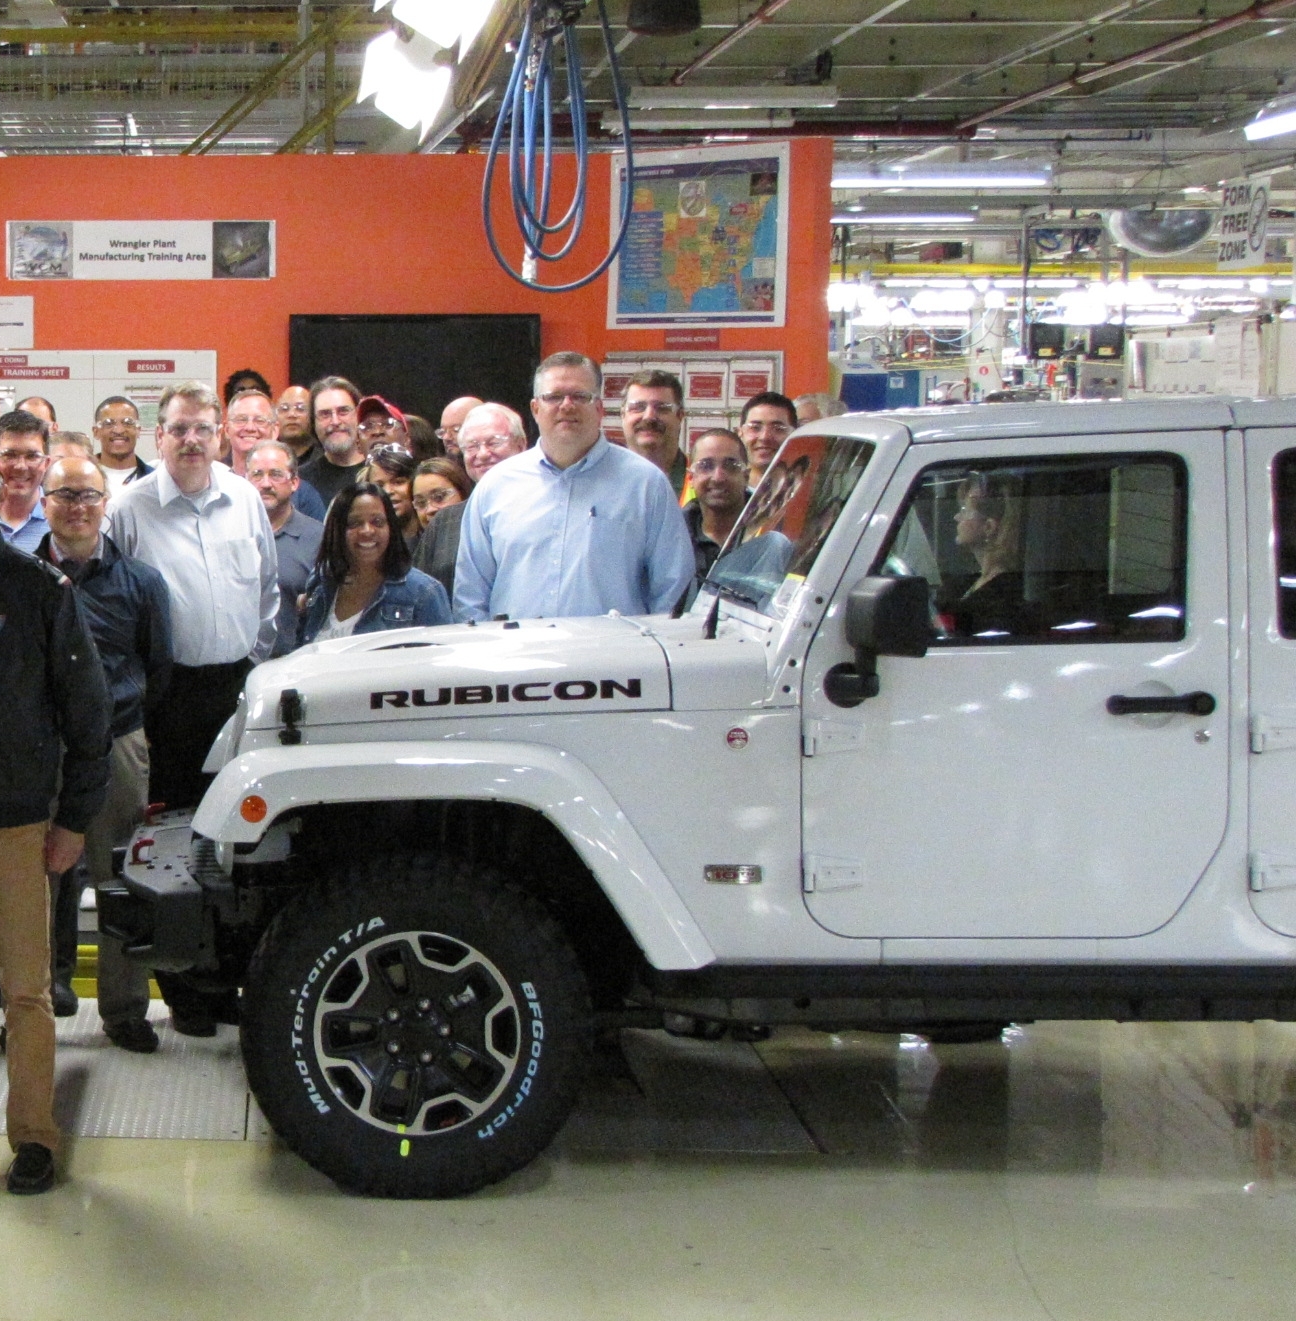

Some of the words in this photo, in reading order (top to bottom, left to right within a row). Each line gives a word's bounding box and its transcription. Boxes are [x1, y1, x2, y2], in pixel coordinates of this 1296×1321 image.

[1222, 184, 1251, 207] FORK
[1222, 212, 1248, 234] FREE
[109, 240, 150, 250] Wrangler
[153, 239, 176, 248] Plant
[1218, 239, 1247, 262] ZONE
[79, 252, 145, 262] Manufacturing
[147, 252, 183, 262] Training
[185, 252, 207, 261] Area
[370, 678, 641, 709] RUBICON
[290, 947, 338, 1115] Mud-Terrain
[338, 916, 386, 945] T/A
[477, 981, 545, 1139] BFGoodrich
